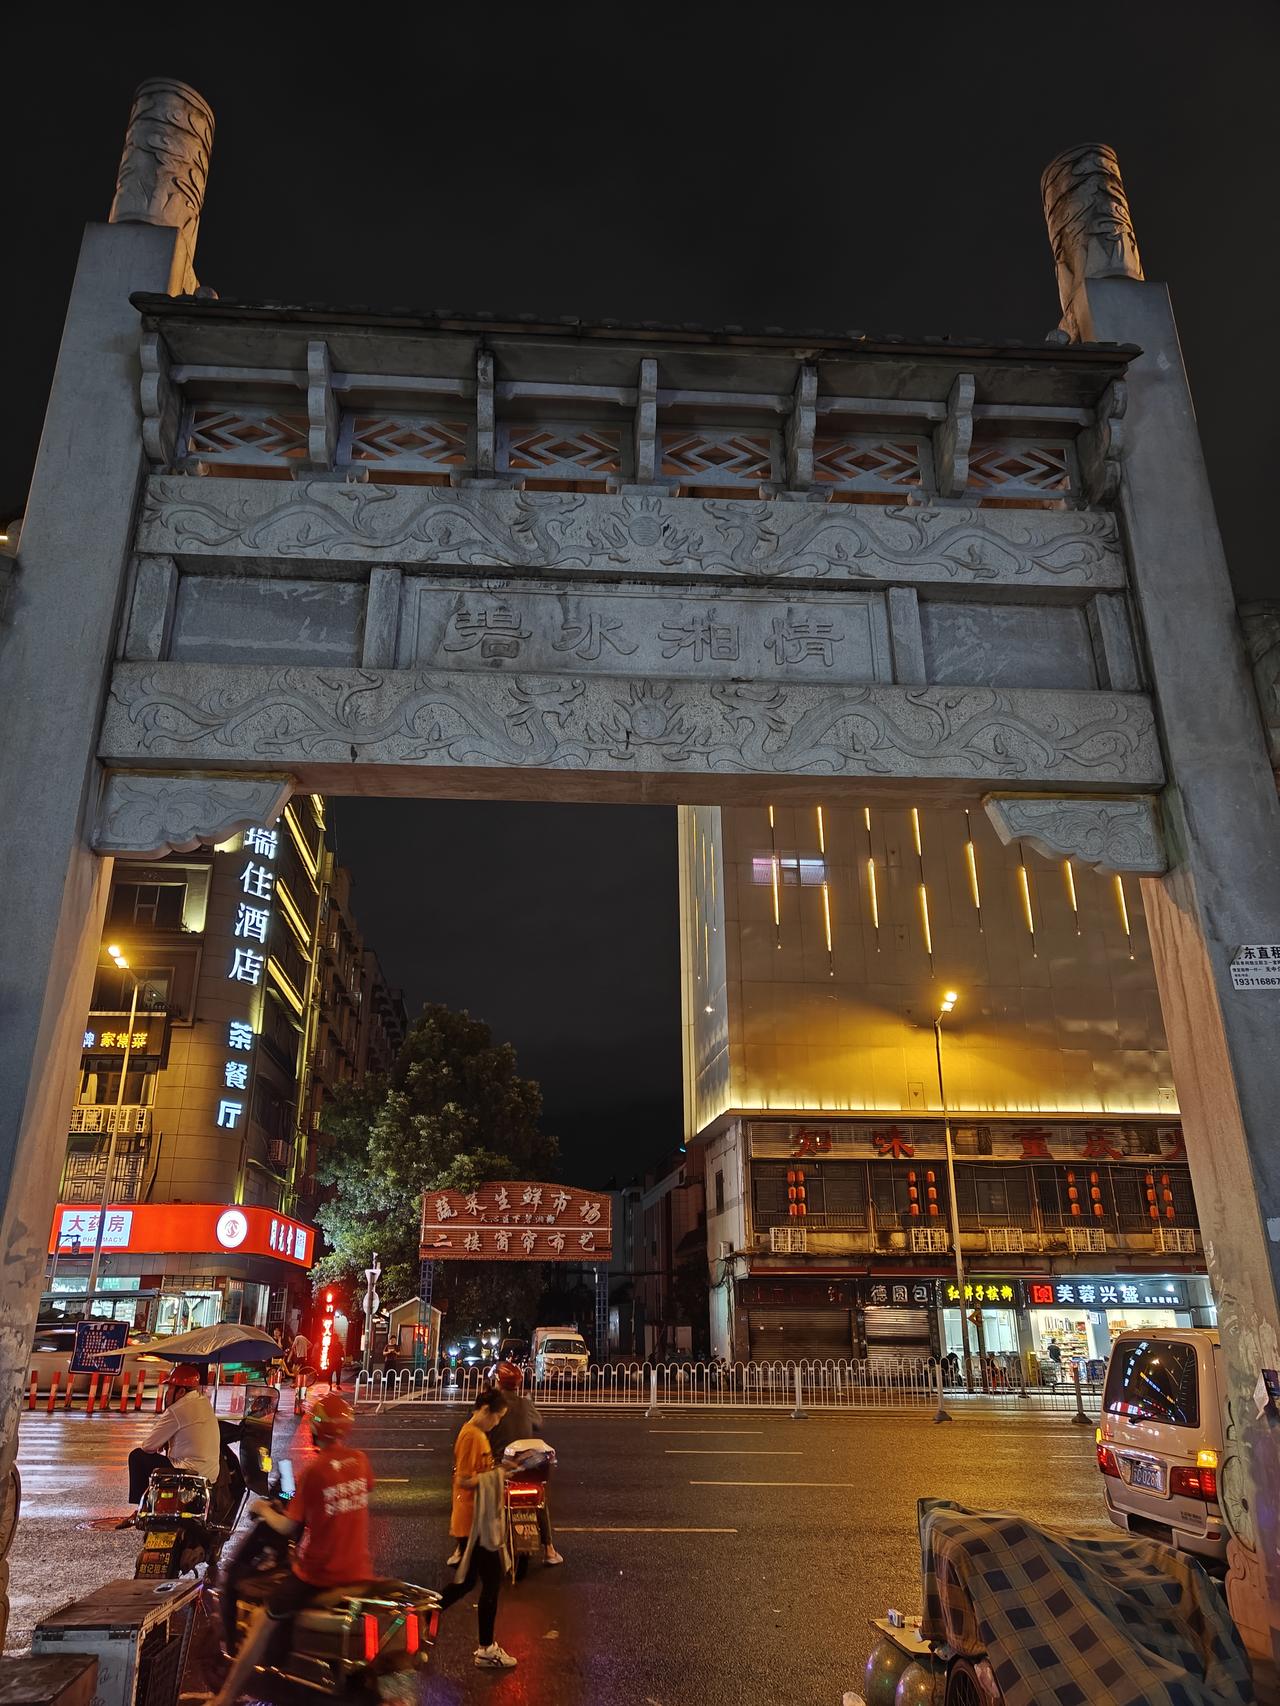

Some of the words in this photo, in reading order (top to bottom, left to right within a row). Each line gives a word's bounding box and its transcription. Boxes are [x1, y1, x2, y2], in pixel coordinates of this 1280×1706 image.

[443, 610, 846, 668] 碧水湘情
[228, 826, 279, 986] 瑞住酒店
[216, 1021, 254, 1130] 茶餐厅
[434, 1186, 602, 1226] 蔬菜生鲜市场
[432, 1229, 597, 1255] 二楼窗帘布艺
[869, 1284, 929, 1303] 德圆包
[1056, 1284, 1140, 1304] 芙蓉兴盛
